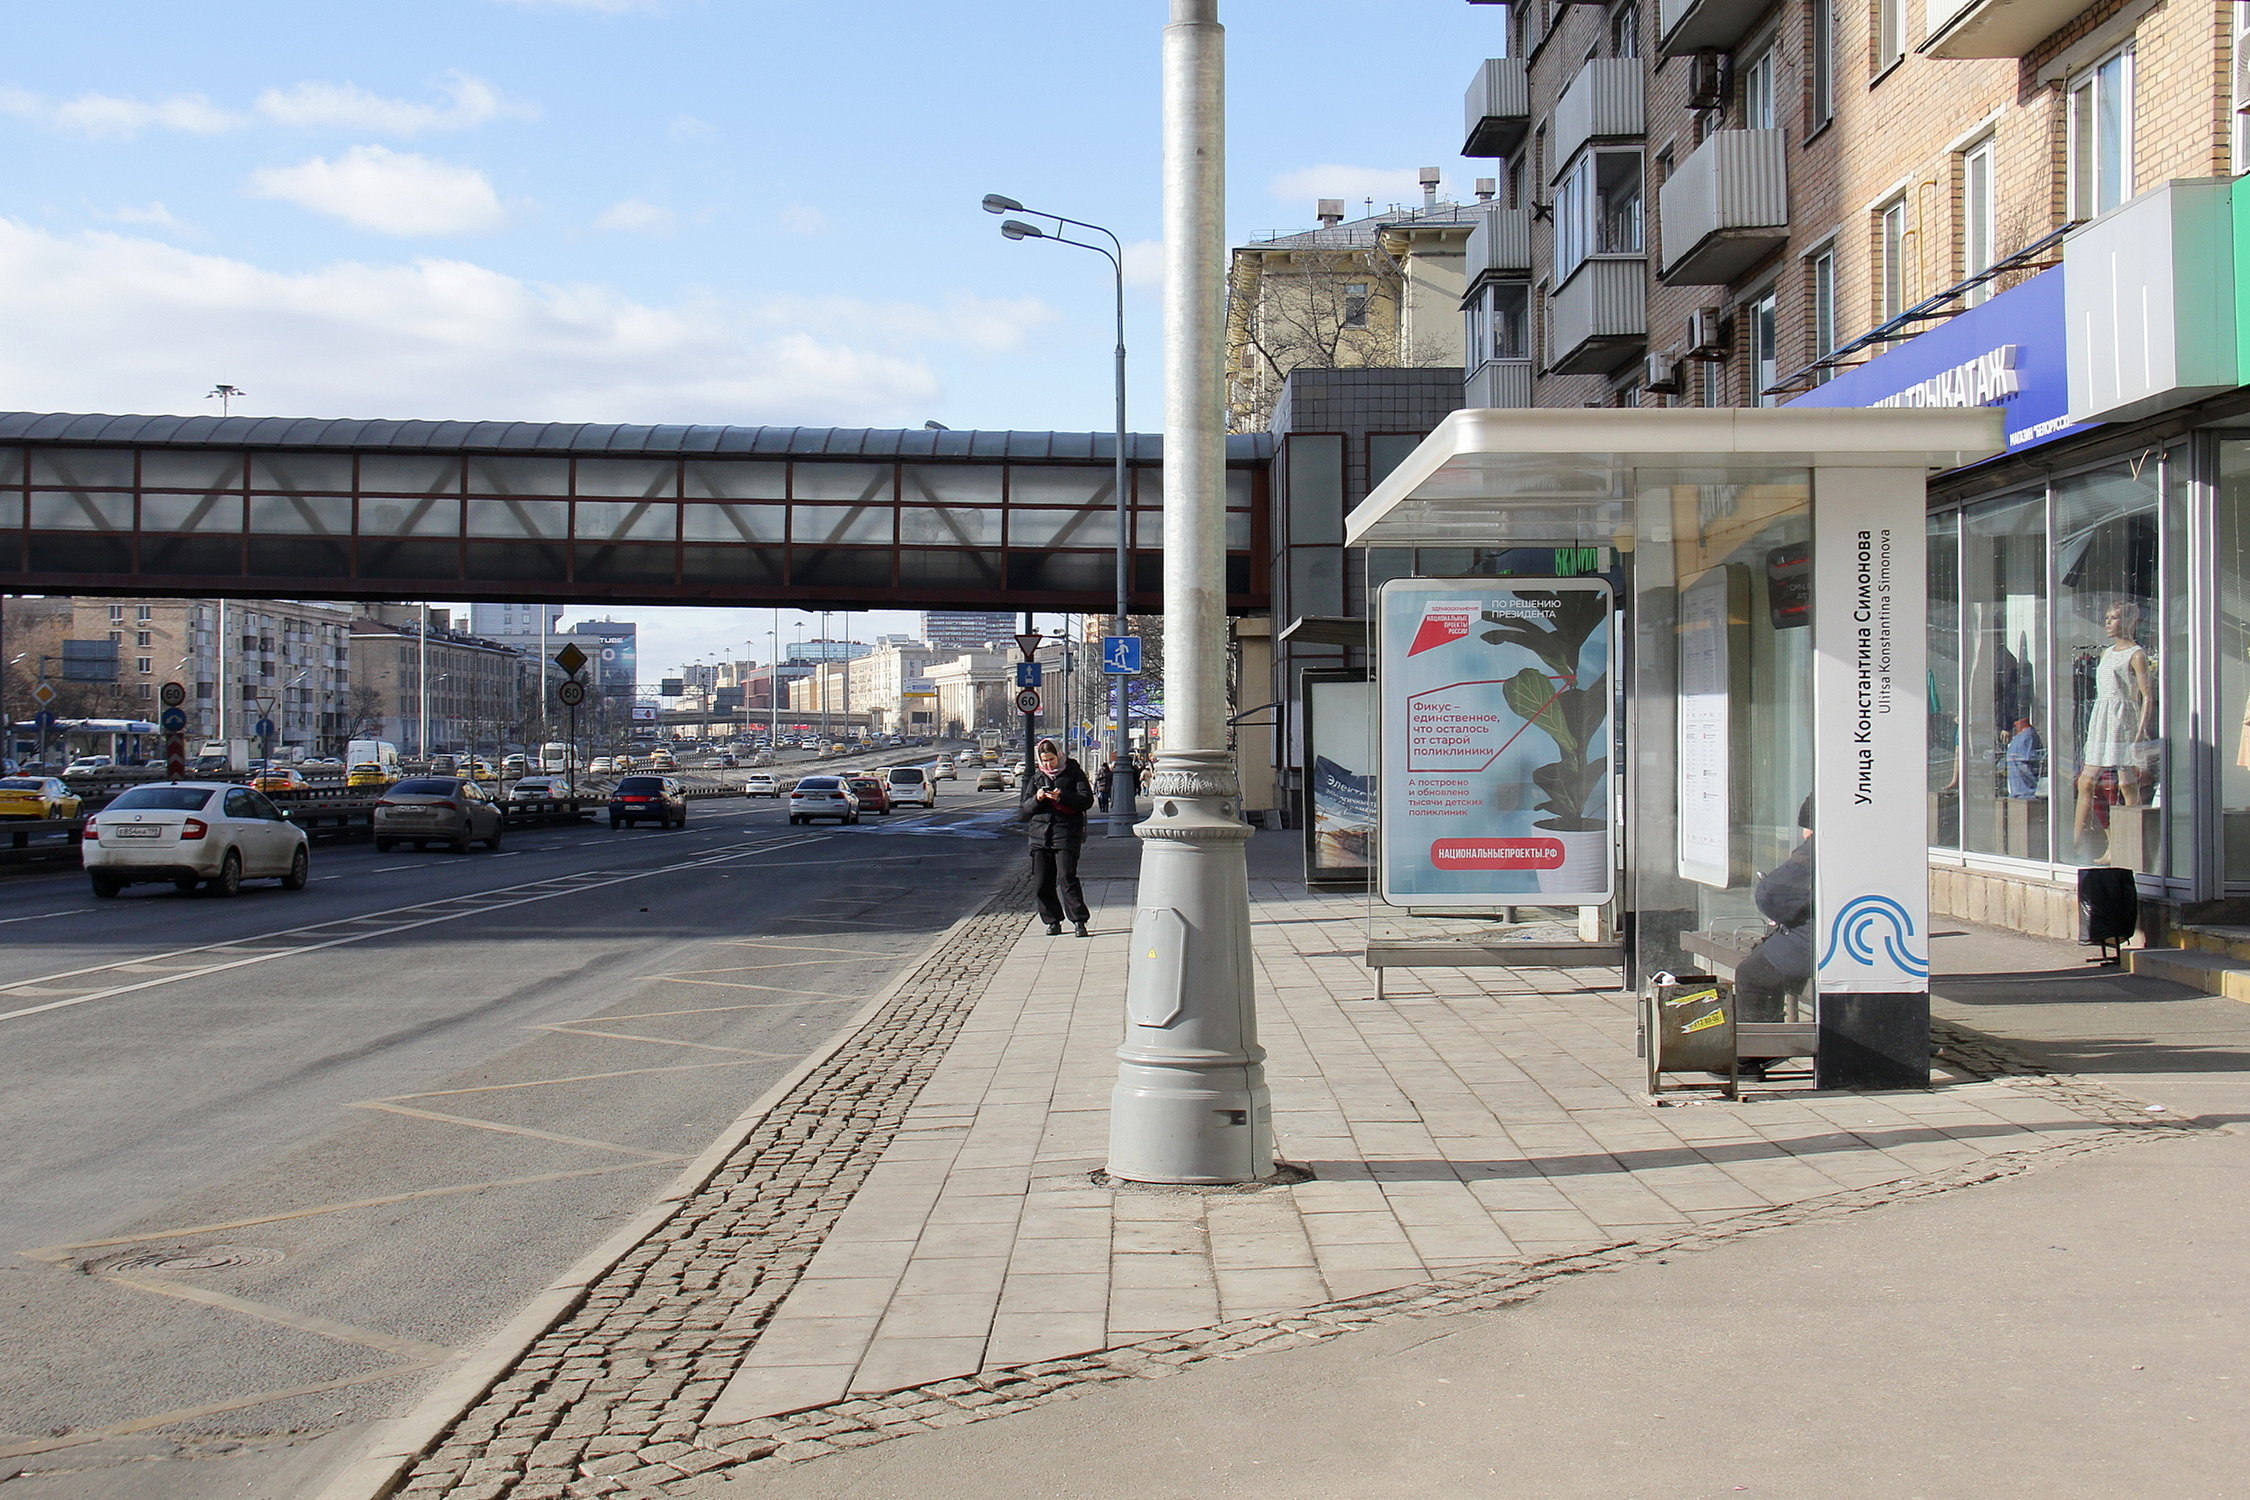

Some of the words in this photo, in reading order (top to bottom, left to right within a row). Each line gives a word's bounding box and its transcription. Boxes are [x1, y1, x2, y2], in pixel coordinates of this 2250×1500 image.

[1878, 529, 1891, 592] Simonova
[1854, 530, 1872, 622] Симонова
[1491, 600, 1506, 608] ПО
[1509, 600, 1562, 608] РЕШЕНИЮ
[1491, 610, 1557, 619] ПРЕЗИДЕНТА
[1878, 595, 1891, 673] Konstantina
[1854, 627, 1872, 743] Константина
[167, 688, 181, 699] 60
[565, 688, 579, 699] 60
[1879, 676, 1891, 714] Ulitsa
[1021, 696, 1035, 706] 60
[1413, 702, 1451, 712] Фикус
[1413, 714, 1500, 723] единственное,
[1429, 735, 1470, 746] старой
[1413, 747, 1494, 756] поликлиники
[1854, 748, 1874, 805] Улица
[1418, 779, 1469, 787] построено
[1417, 788, 1470, 796] обновлено
[1445, 799, 1484, 807] детских
[1438, 847, 1558, 859] НАЦИОНАЛЬНЫЕПРОЕКТЫ.РФ
